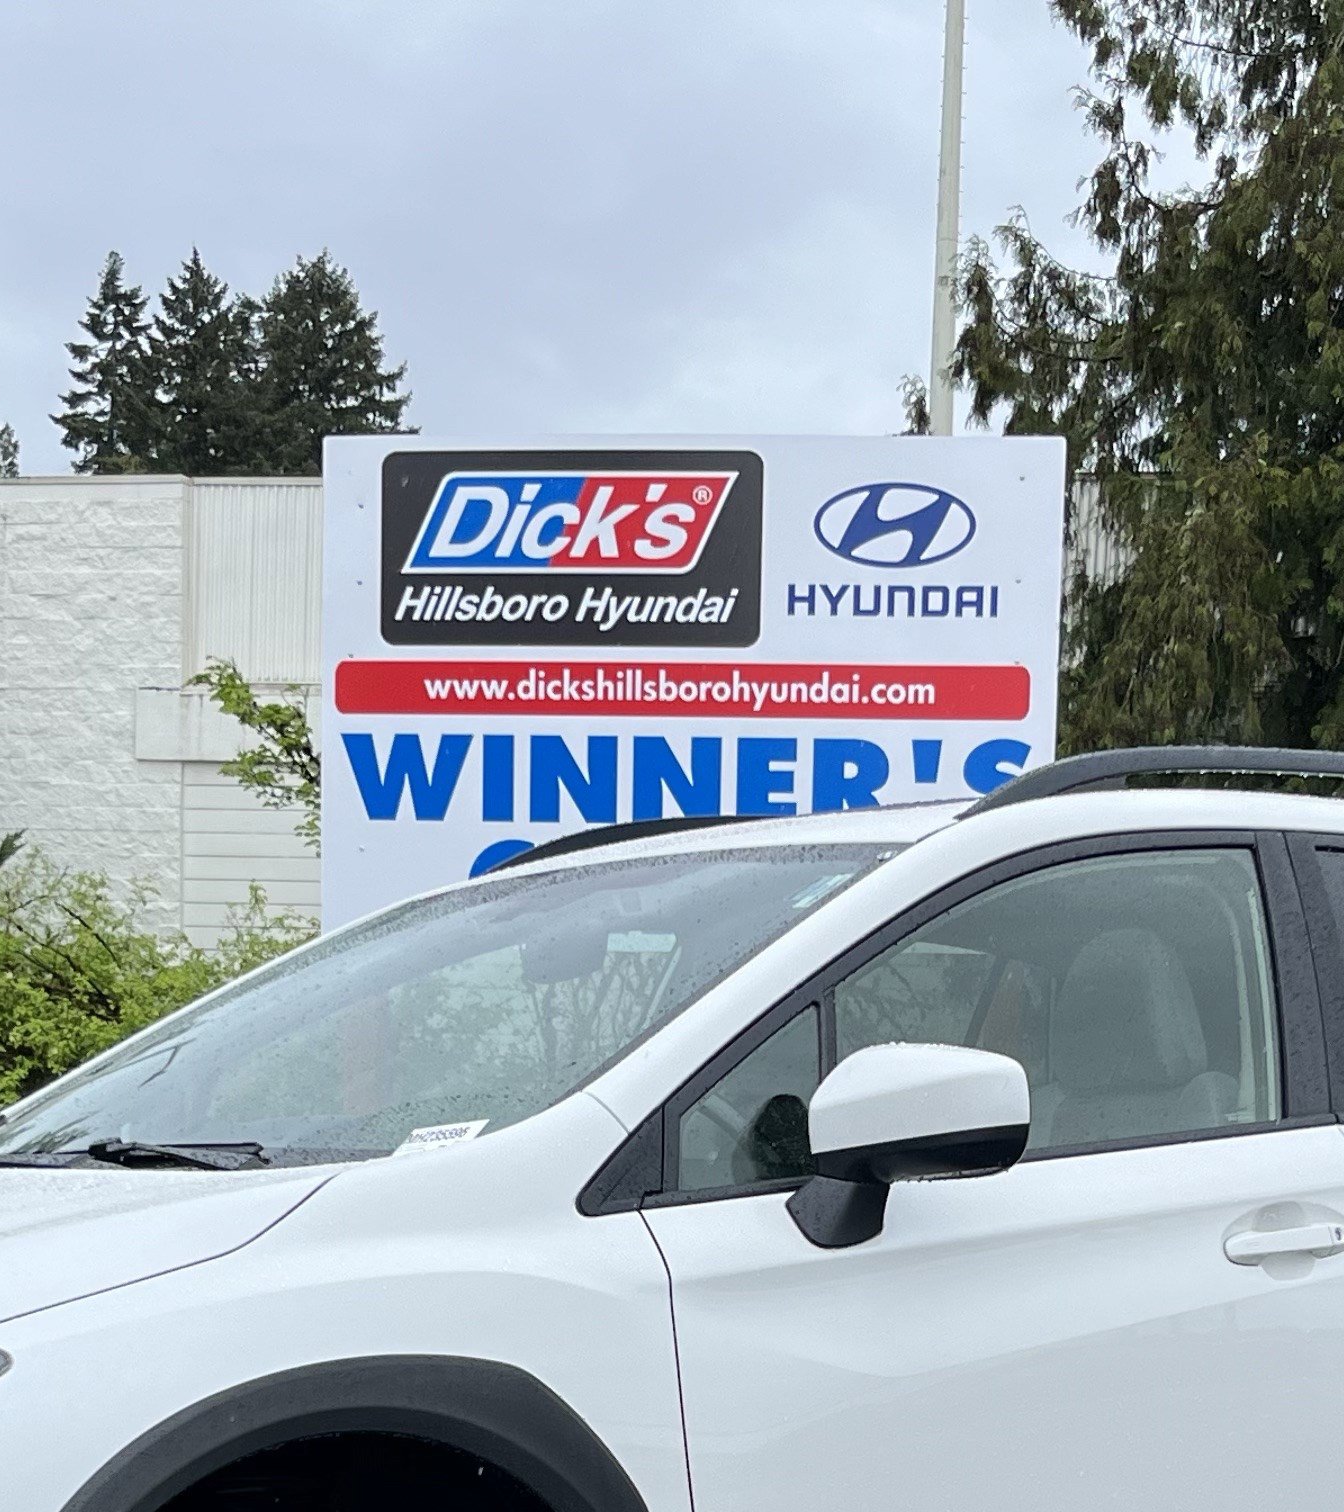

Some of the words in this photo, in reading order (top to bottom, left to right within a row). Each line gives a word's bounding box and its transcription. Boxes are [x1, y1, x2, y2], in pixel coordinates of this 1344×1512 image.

[429, 481, 694, 559] Dick's
[395, 586, 570, 623] Hillsboro
[576, 588, 740, 631] Hyundai
[787, 584, 999, 618] HYUNDAI
[424, 671, 937, 712] www.dickshillsborohyundai.com
[342, 732, 1032, 823] WINNER'S
